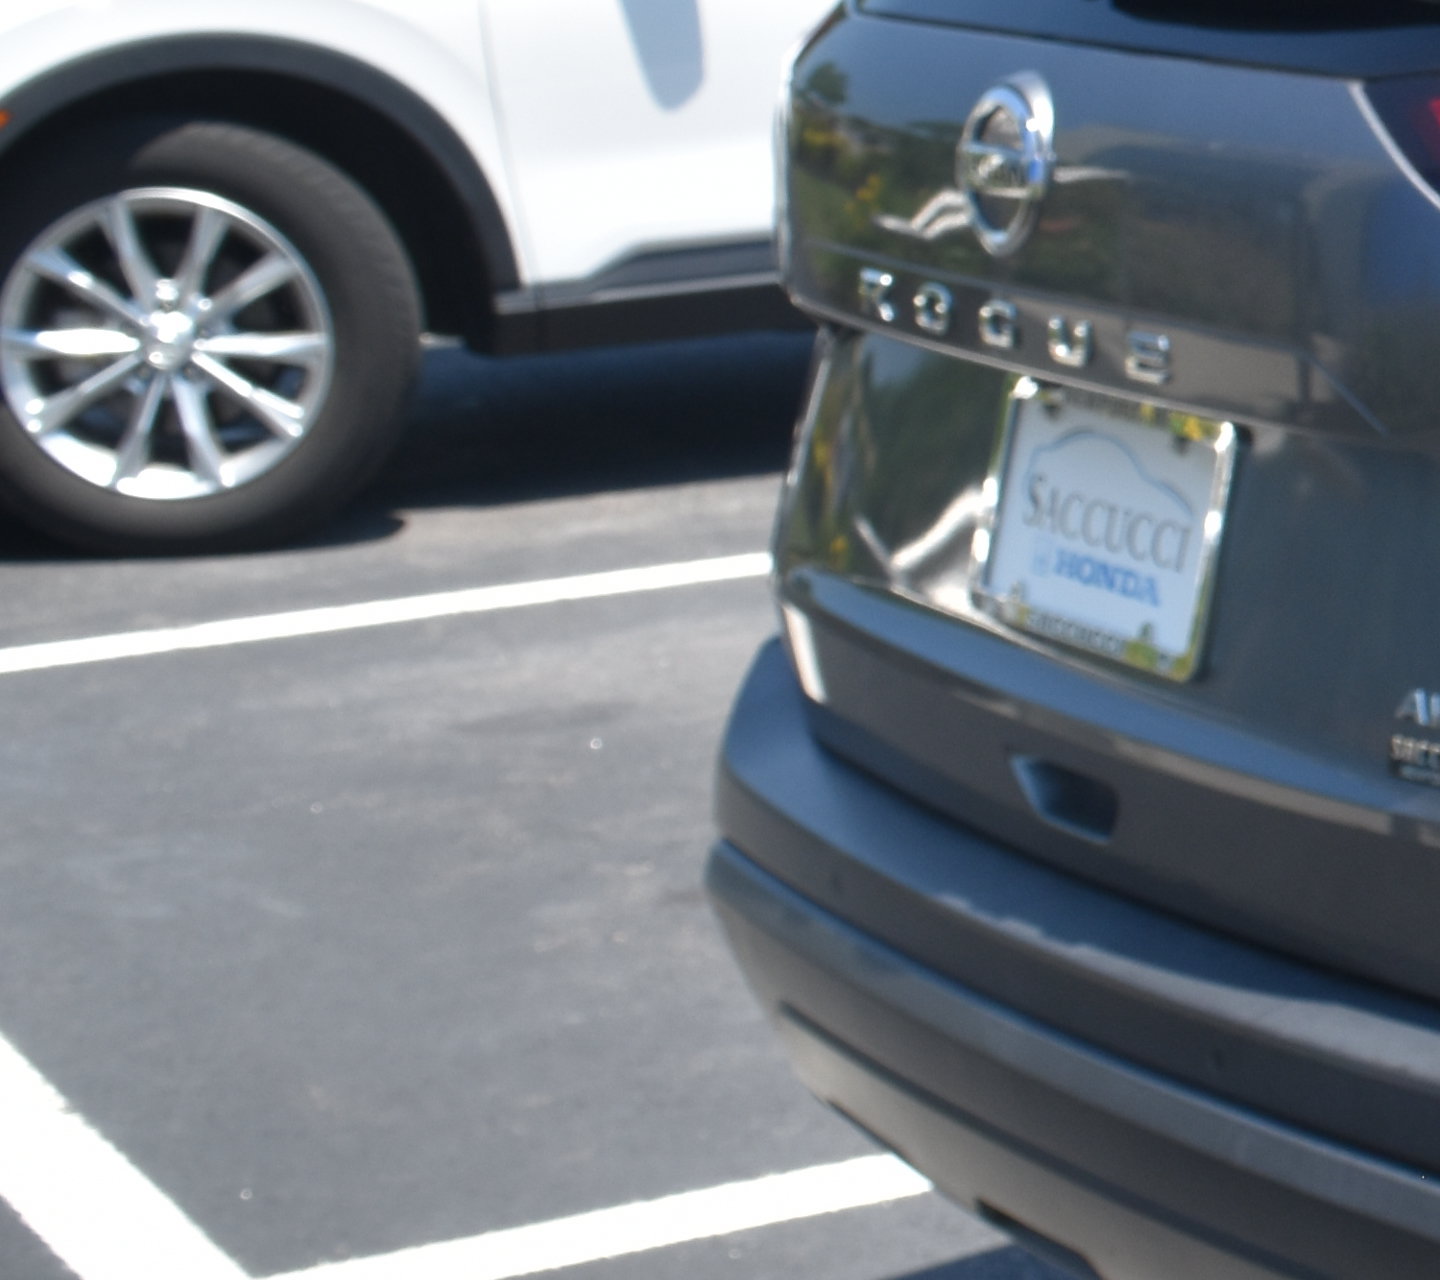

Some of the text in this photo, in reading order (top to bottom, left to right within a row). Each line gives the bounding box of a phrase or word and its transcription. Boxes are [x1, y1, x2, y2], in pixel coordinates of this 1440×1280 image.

[858, 265, 1170, 387] ROGUE
[1022, 473, 1193, 572] SACCUCCI
[1052, 547, 1161, 609] HONDA
